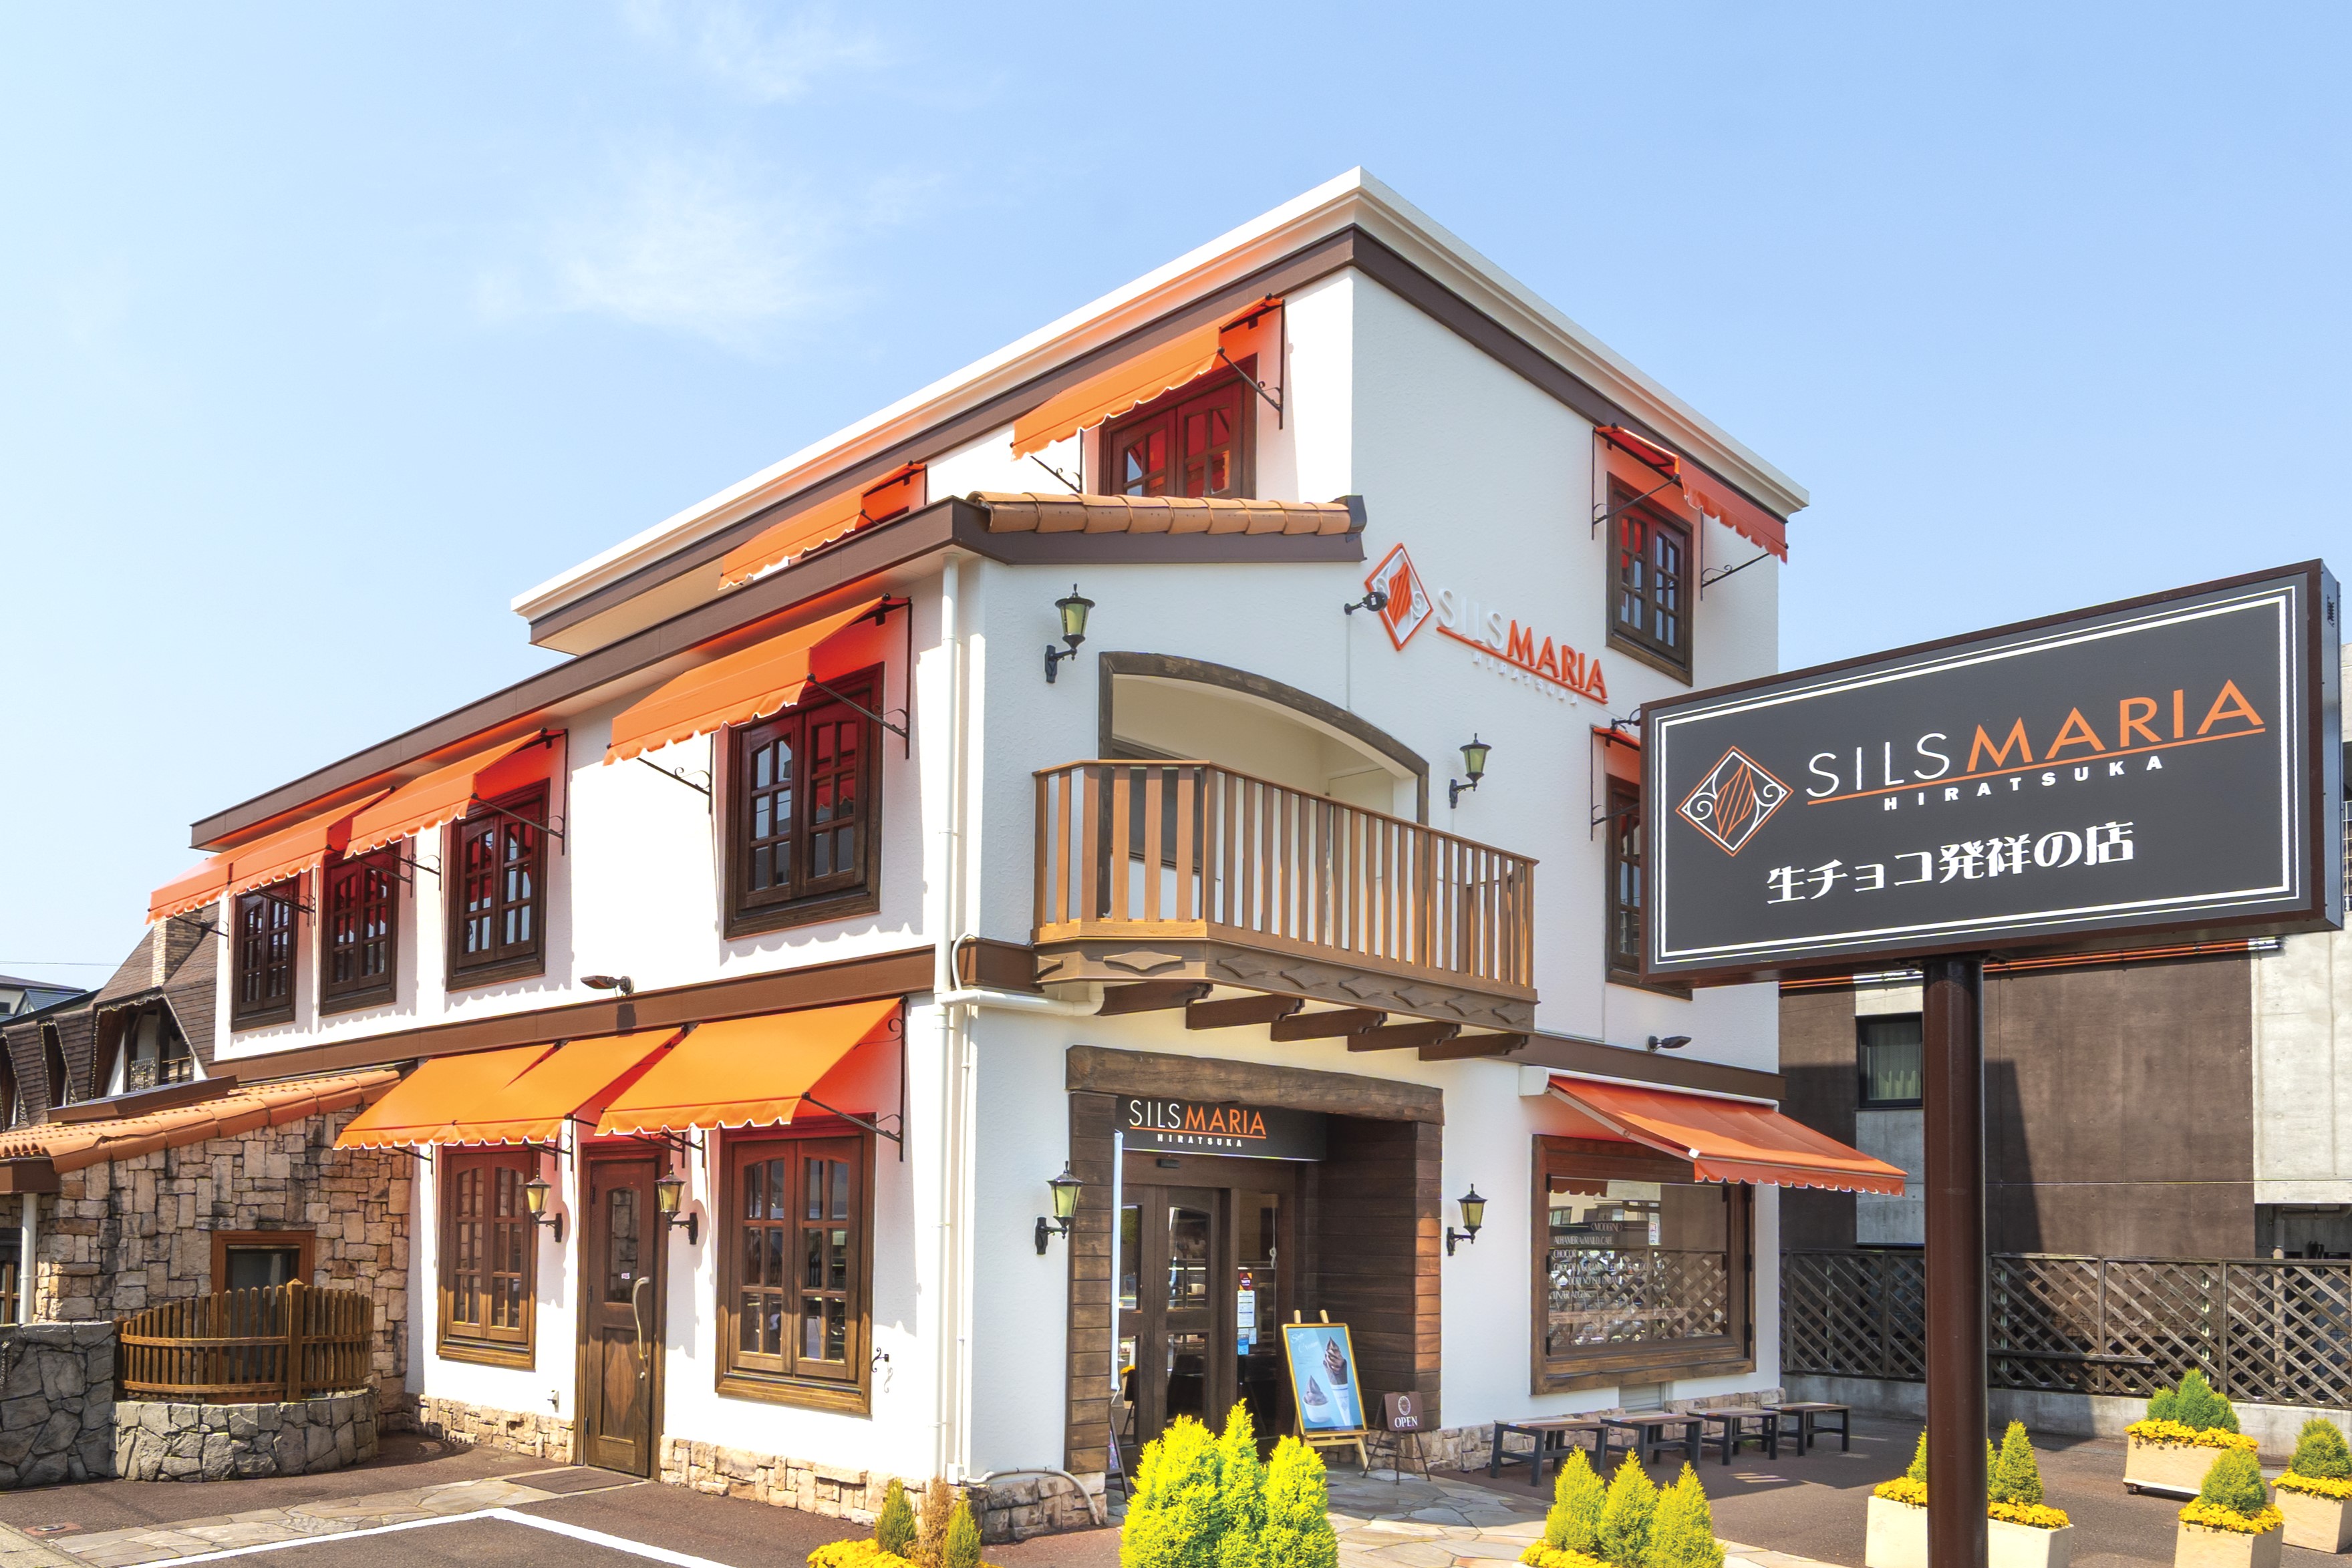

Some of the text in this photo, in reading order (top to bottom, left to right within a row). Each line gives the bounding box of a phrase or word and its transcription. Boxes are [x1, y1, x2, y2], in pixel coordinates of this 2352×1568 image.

[1472, 651, 1579, 706] HIRATSUKA
[1805, 679, 2265, 798] SILSMARIA
[1884, 755, 2164, 812] HIRATSUKA
[1767, 820, 2135, 905] 生チョコ発祥の店
[1129, 1100, 1267, 1136] SILSMARIA
[1157, 1134, 1242, 1148] HIRATSUKA
[1394, 1416, 1418, 1428] OPEN
